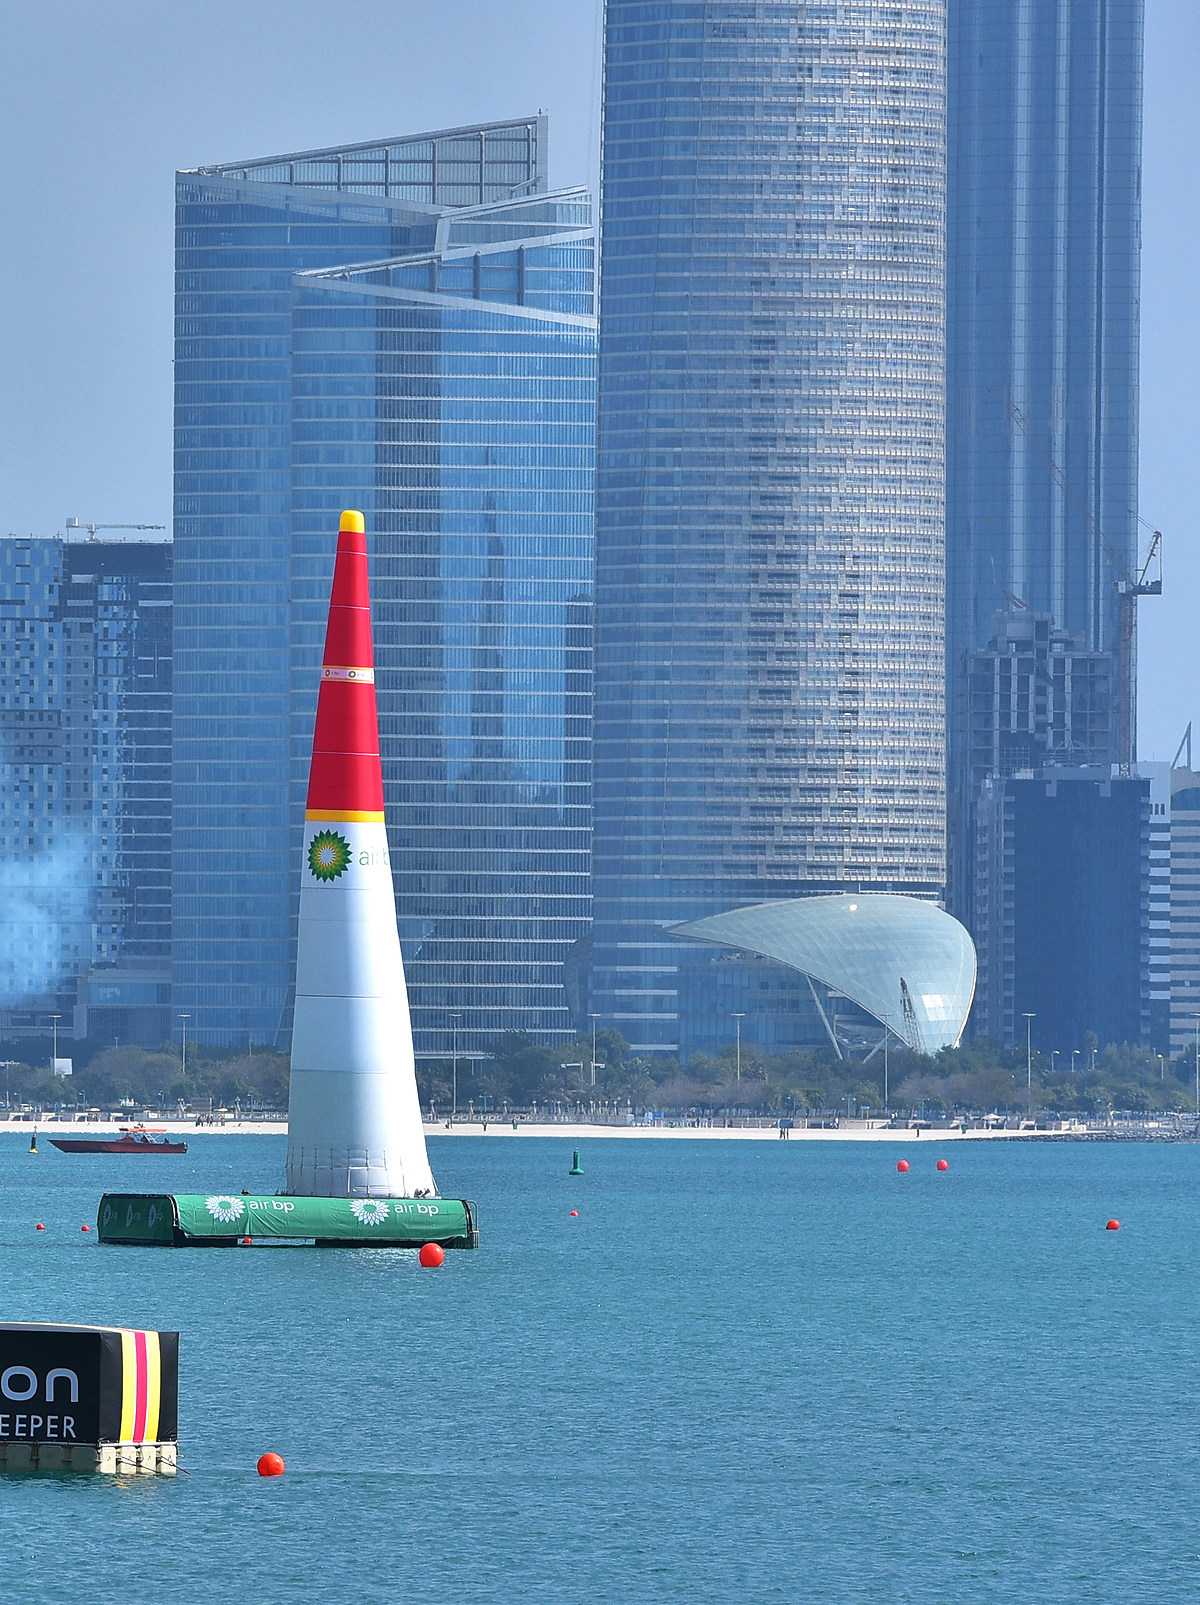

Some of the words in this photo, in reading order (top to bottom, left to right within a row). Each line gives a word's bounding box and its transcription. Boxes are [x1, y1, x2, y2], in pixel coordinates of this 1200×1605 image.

[250, 1200, 268, 1210] air
[272, 1200, 295, 1213] bp
[395, 1203, 413, 1213] air
[418, 1203, 439, 1216] bp
